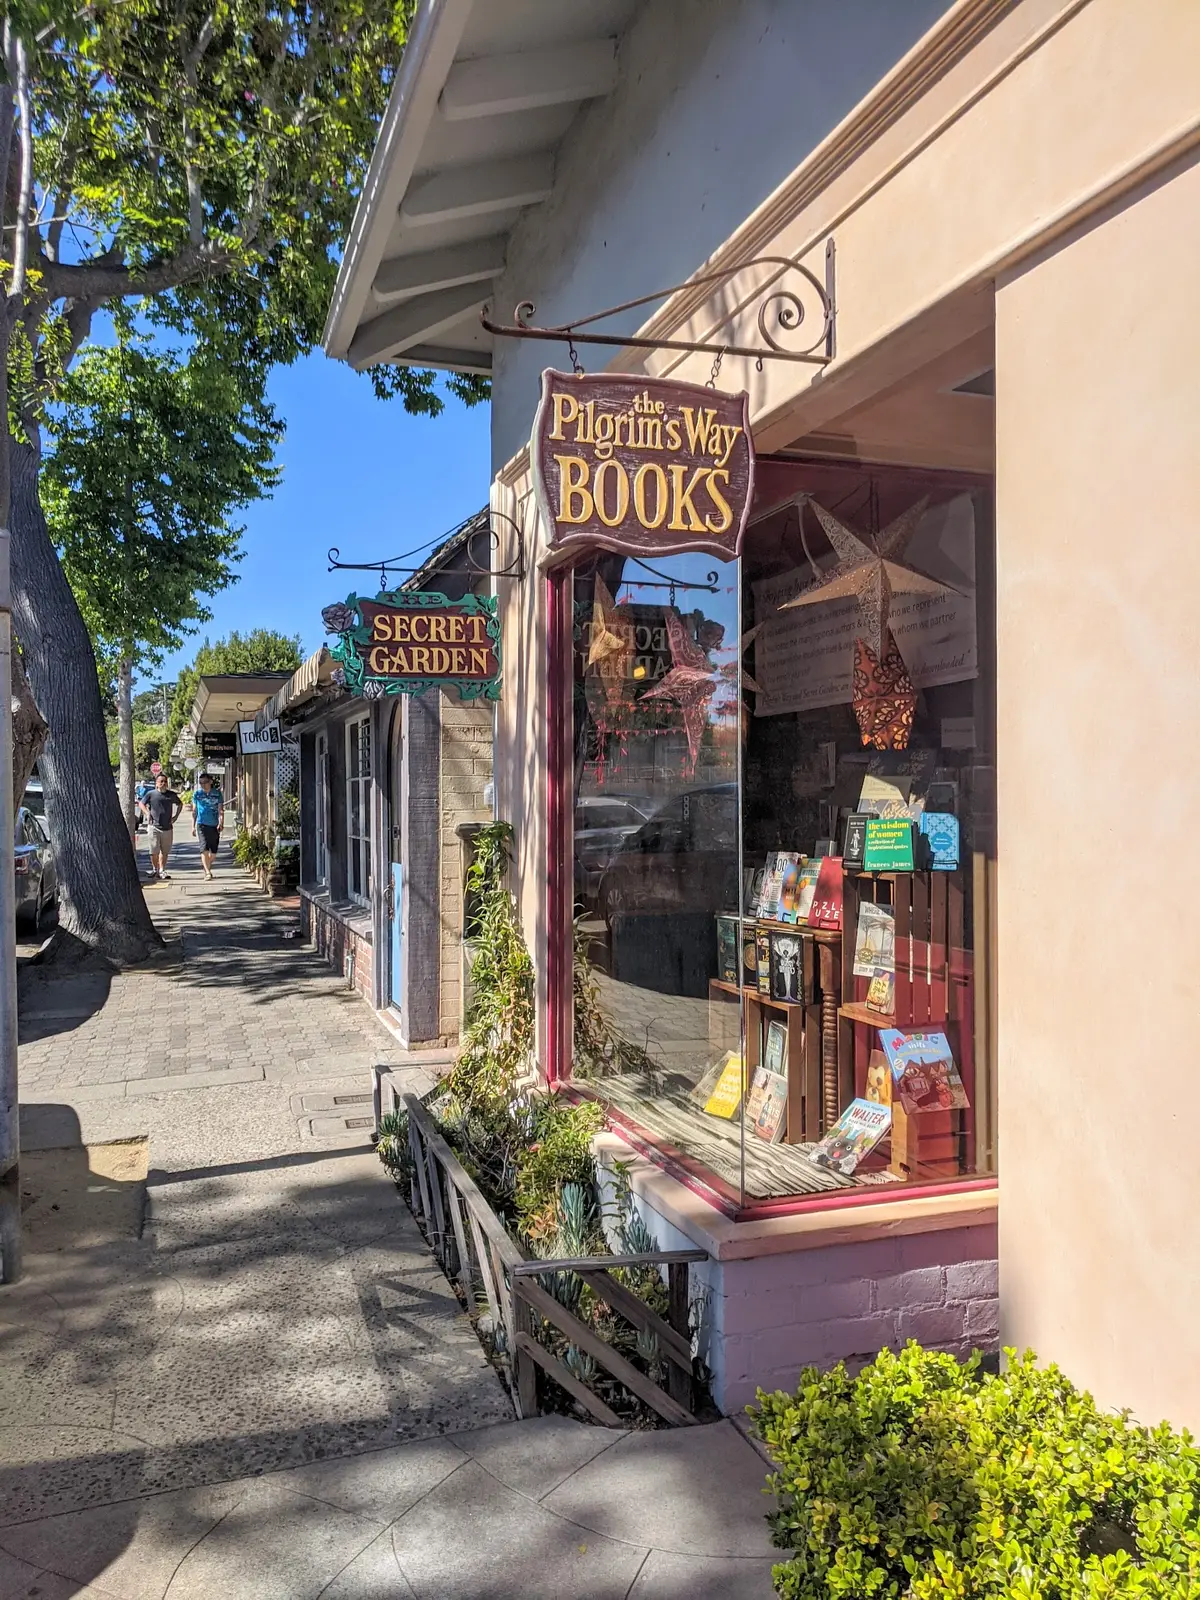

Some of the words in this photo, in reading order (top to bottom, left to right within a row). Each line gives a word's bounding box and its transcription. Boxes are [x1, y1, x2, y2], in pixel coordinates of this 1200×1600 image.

[632, 390, 665, 414] the
[549, 393, 682, 460] Pilgrim's
[679, 406, 743, 468] Way
[553, 454, 734, 533] BOOKS
[384, 593, 443, 604] THE
[373, 614, 486, 644] SECRET
[369, 646, 489, 675] GARDEN
[242, 730, 269, 744] TORO
[868, 822, 880, 830] the
[881, 821, 909, 830] wisdom
[851, 1107, 886, 1125] WALTER
